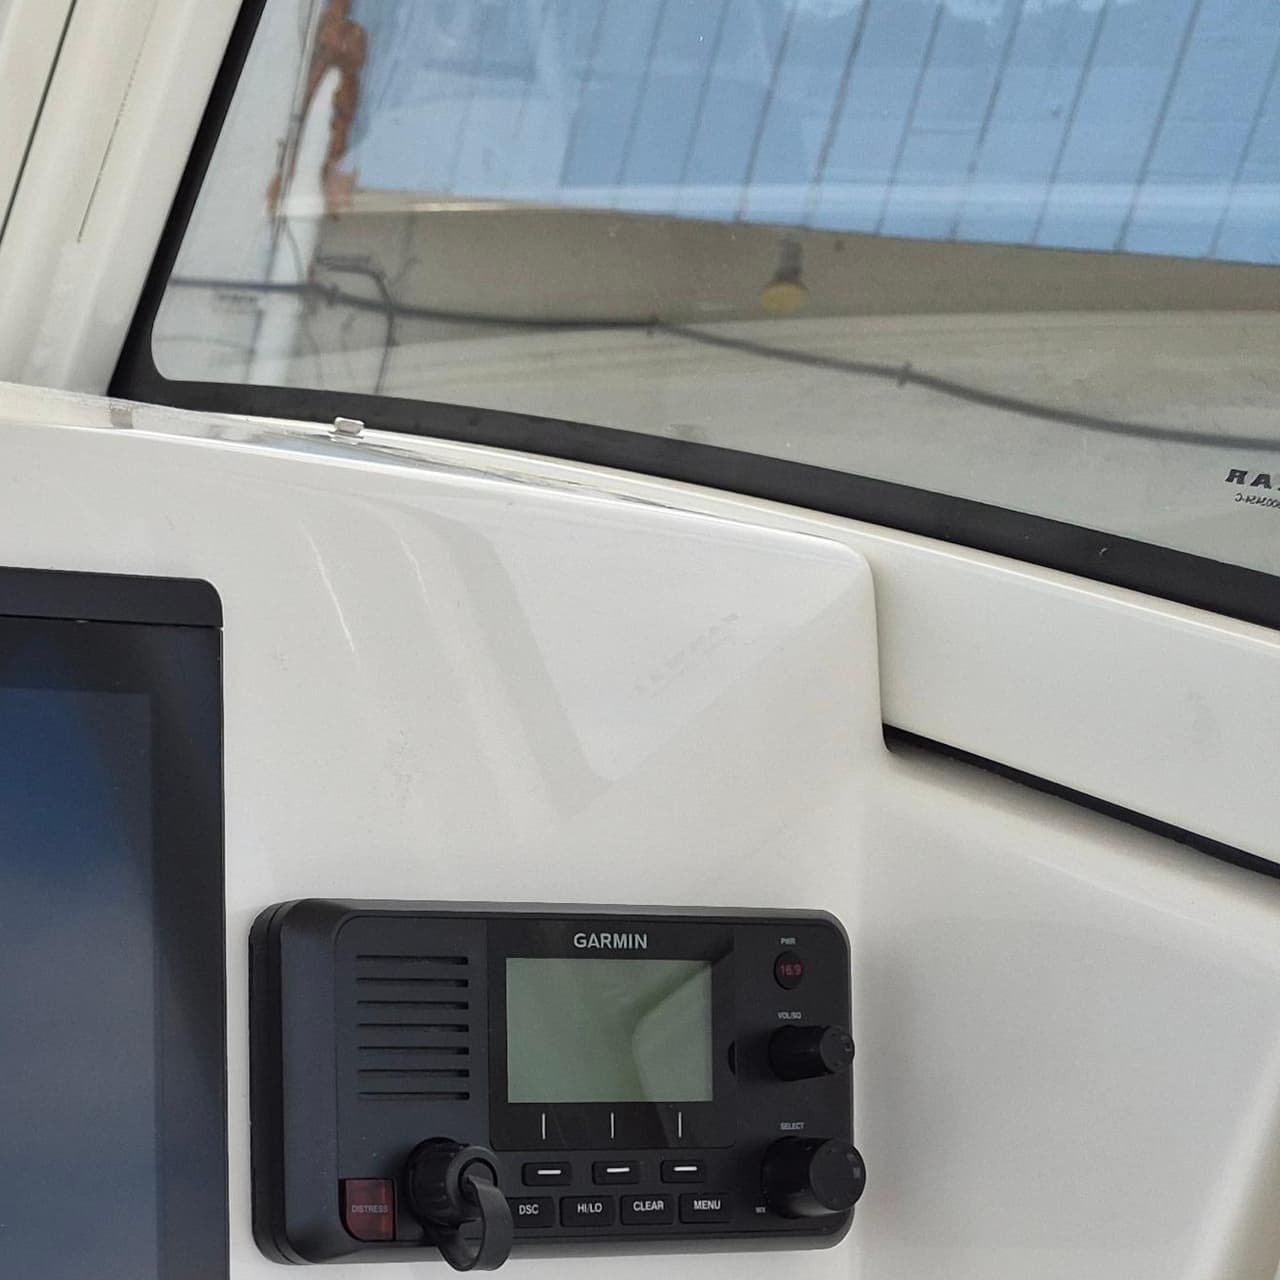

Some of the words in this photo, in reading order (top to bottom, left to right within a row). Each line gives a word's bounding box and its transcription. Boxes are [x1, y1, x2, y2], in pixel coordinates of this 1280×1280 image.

[574, 932, 648, 949] GARMIN
[780, 1122, 805, 1130] SELECT
[352, 1204, 388, 1214] DISTRESS
[519, 1204, 539, 1215] DSC
[577, 1203, 602, 1213] HI/LO
[633, 1200, 664, 1211] CLEAR
[694, 1200, 720, 1210] MENU
